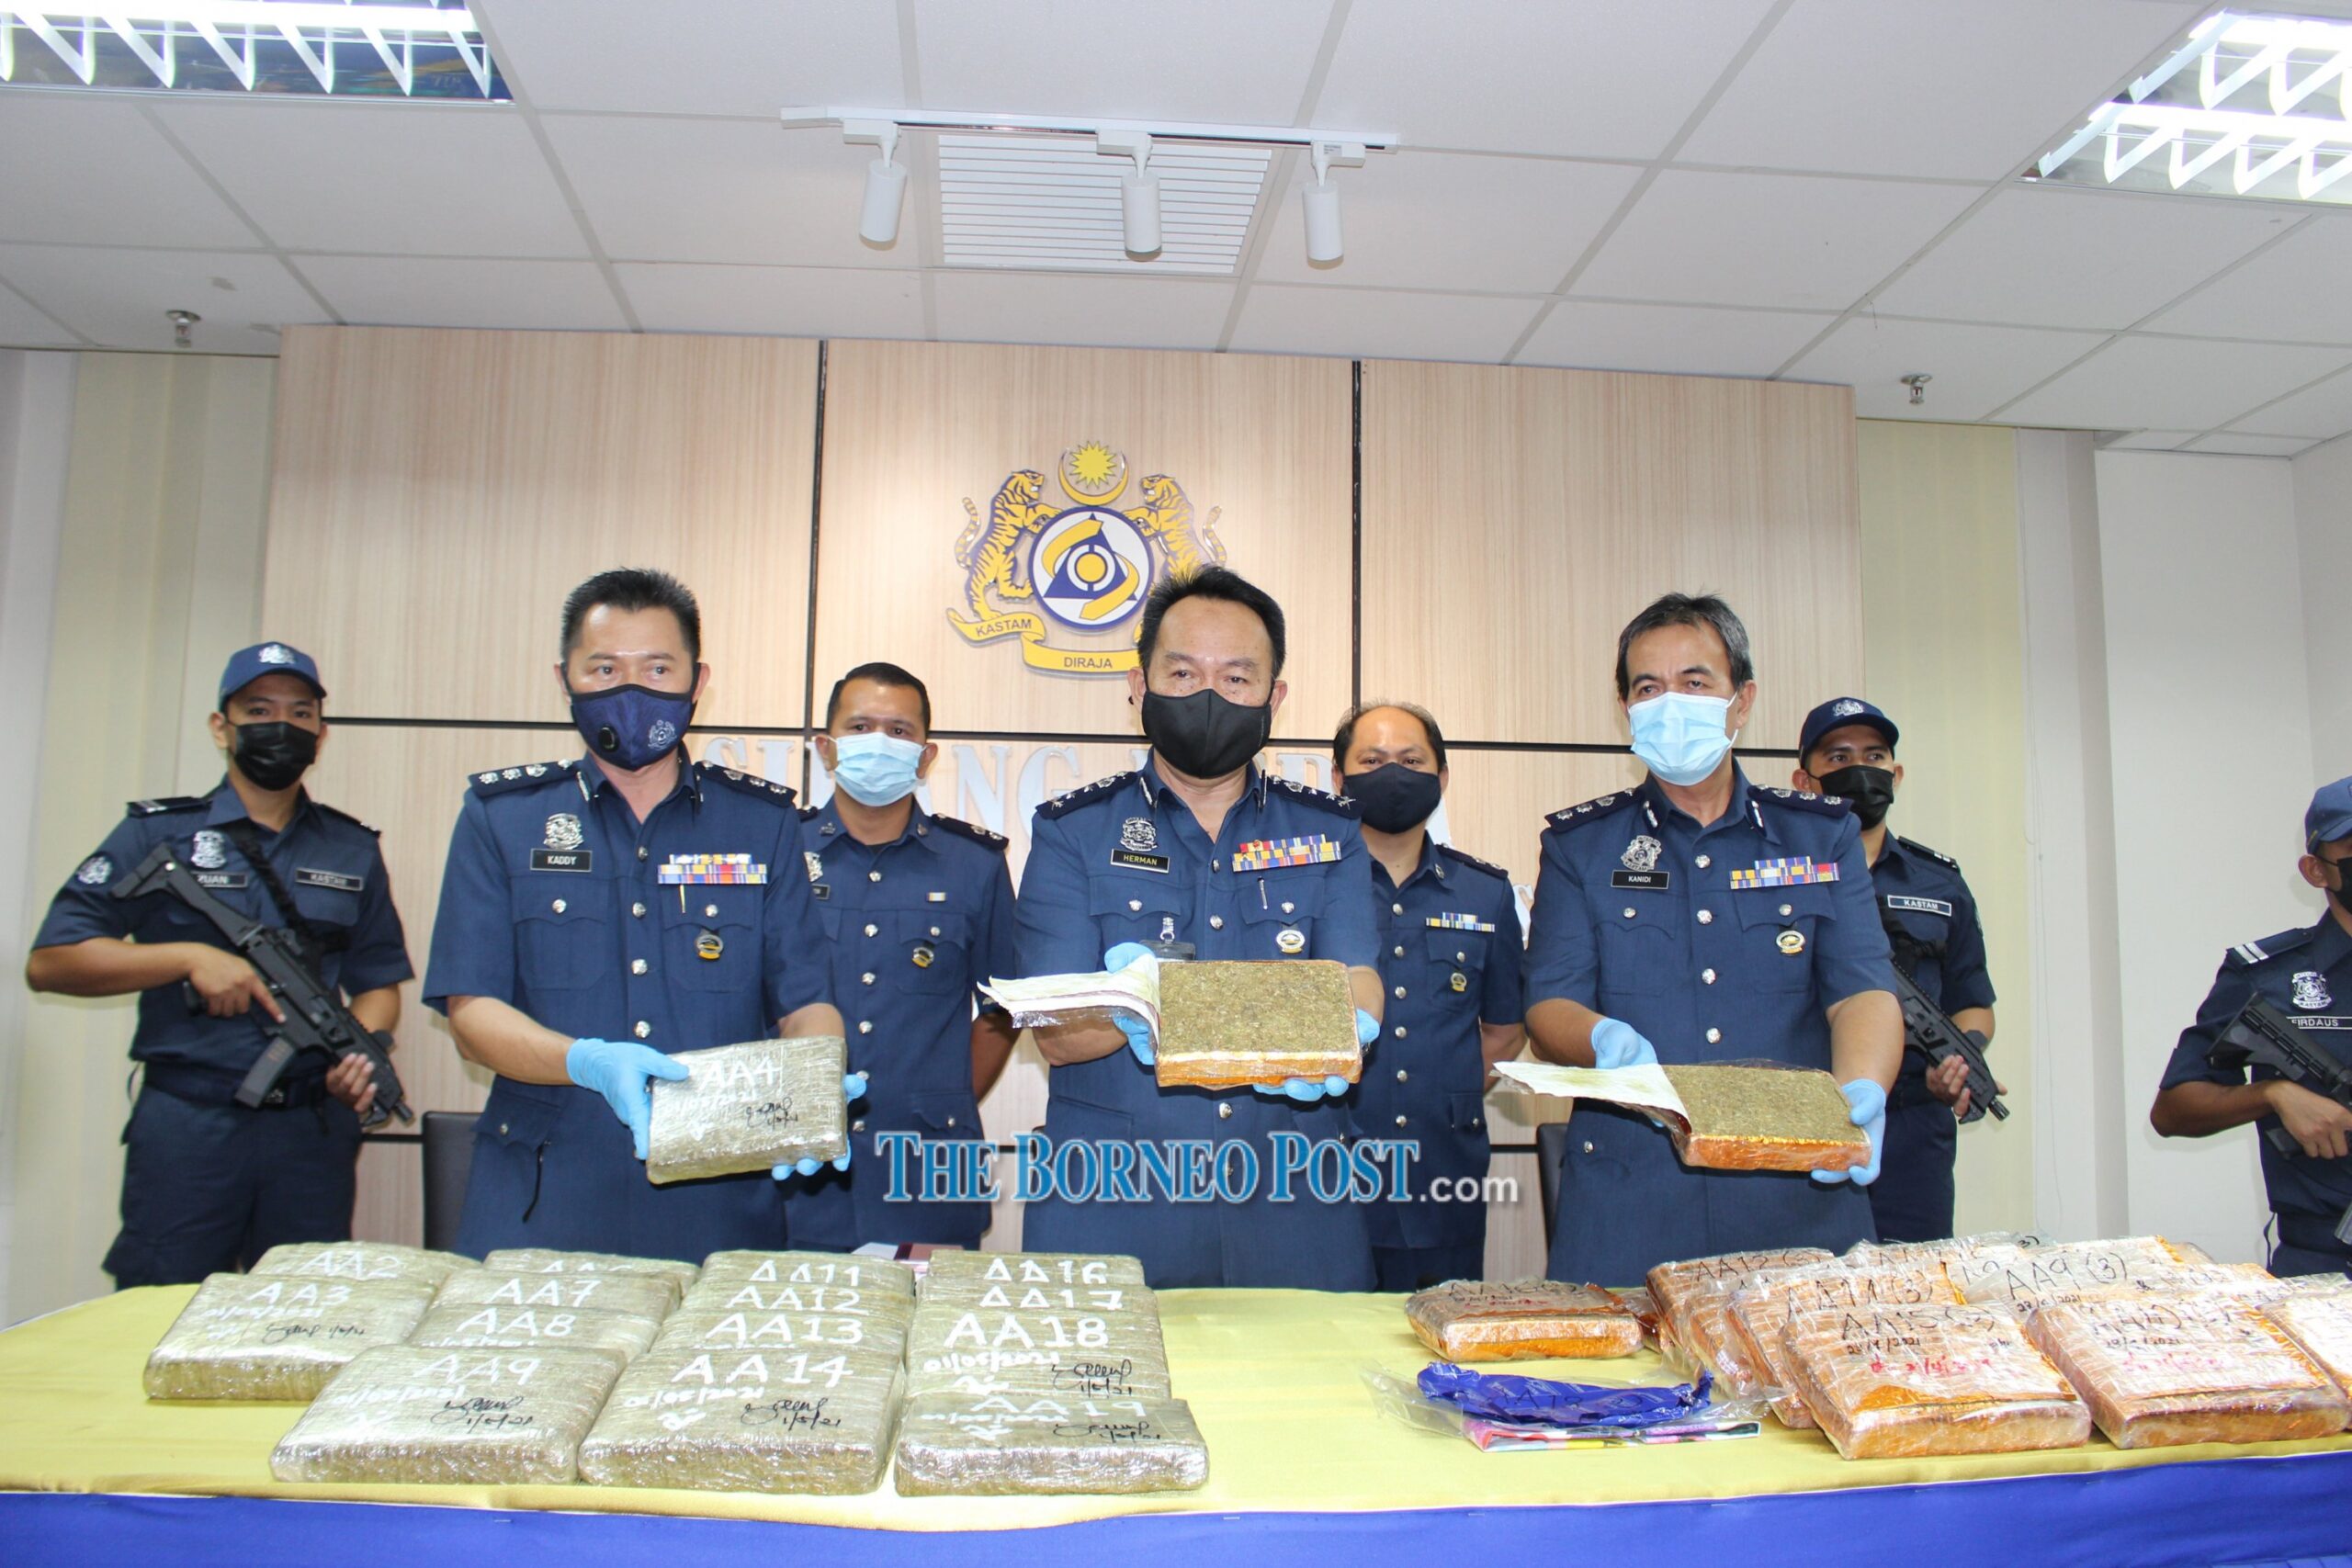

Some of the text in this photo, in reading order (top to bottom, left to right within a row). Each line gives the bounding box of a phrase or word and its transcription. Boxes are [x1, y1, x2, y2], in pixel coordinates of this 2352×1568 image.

[975, 618, 1032, 637] KASTAM
[1063, 656, 1113, 669] DIRAJA
[548, 855, 577, 865] KADDY
[1123, 853, 1158, 866] HERMAN
[1628, 874, 1652, 884] KANIDI
[1904, 899, 1939, 910] KASTAM
[695, 1056, 782, 1091] AA4
[296, 1250, 401, 1280] AA2
[749, 1259, 860, 1287] AA11
[2086, 1251, 2128, 1284] (3)
[245, 1282, 353, 1307] AA3
[484, 1278, 601, 1308] AA7
[724, 1285, 869, 1316] AA12
[979, 1286, 1124, 1311] AA17
[456, 1307, 577, 1337] AA8
[704, 1313, 864, 1345] AA13
[944, 1312, 1110, 1349] AA18
[413, 1353, 543, 1386] AA9
[671, 1354, 854, 1389] AA14
[969, 1396, 1147, 1417] AA19
